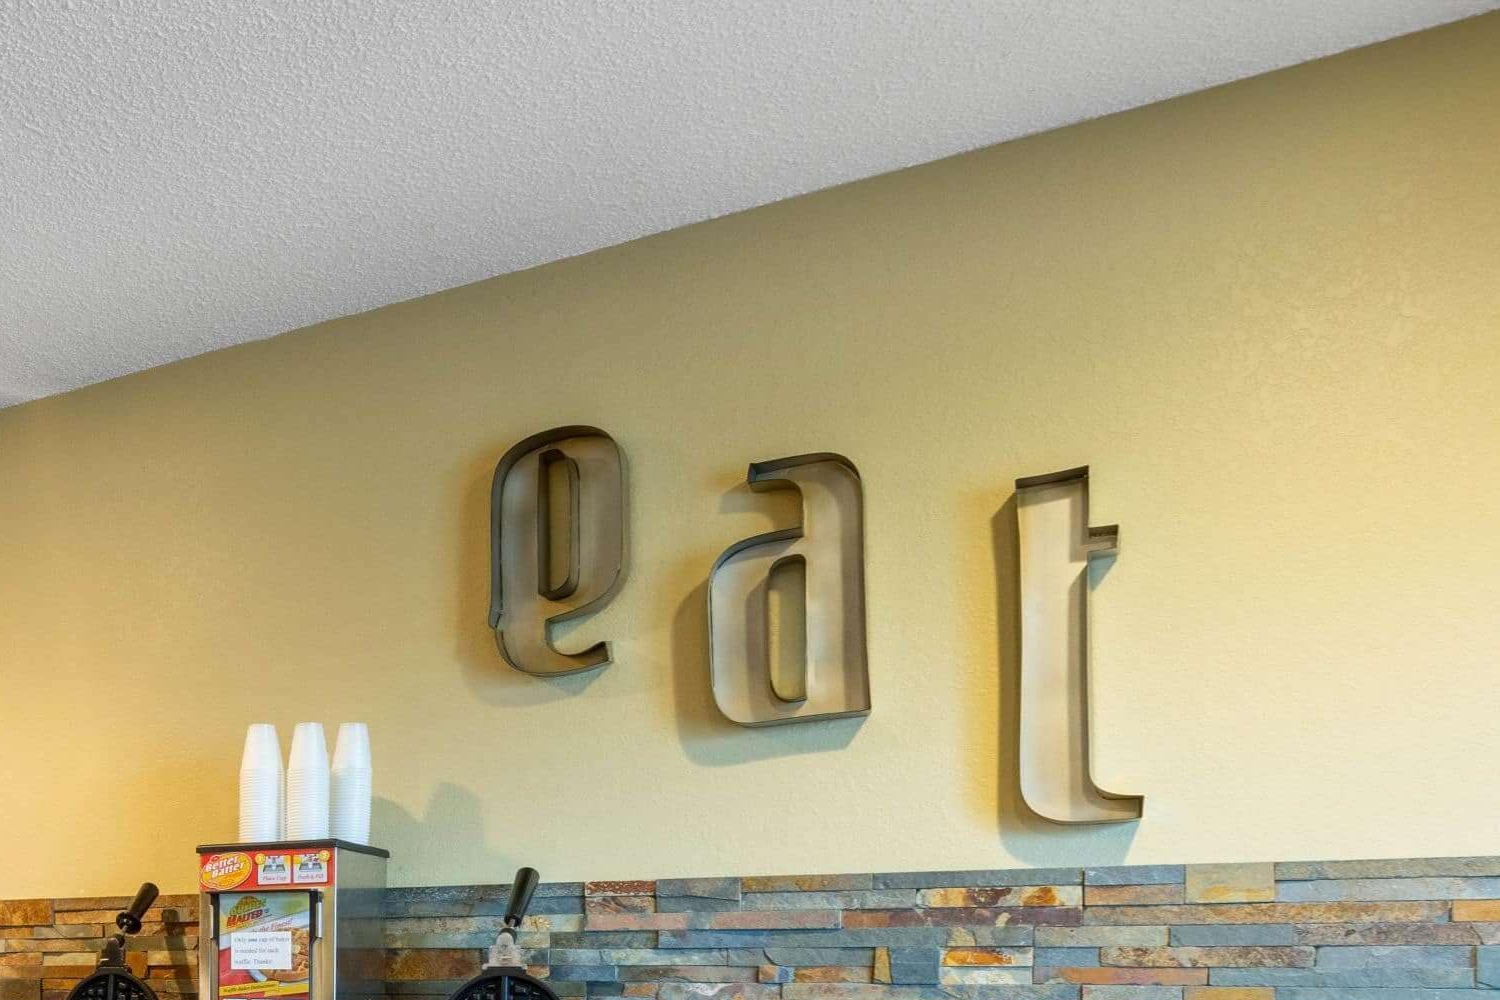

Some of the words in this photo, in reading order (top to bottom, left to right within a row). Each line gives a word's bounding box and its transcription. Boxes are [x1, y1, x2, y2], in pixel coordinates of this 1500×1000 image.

[488, 424, 1145, 825] eat
[205, 855, 239, 872] Better
[211, 862, 245, 879] Batter
